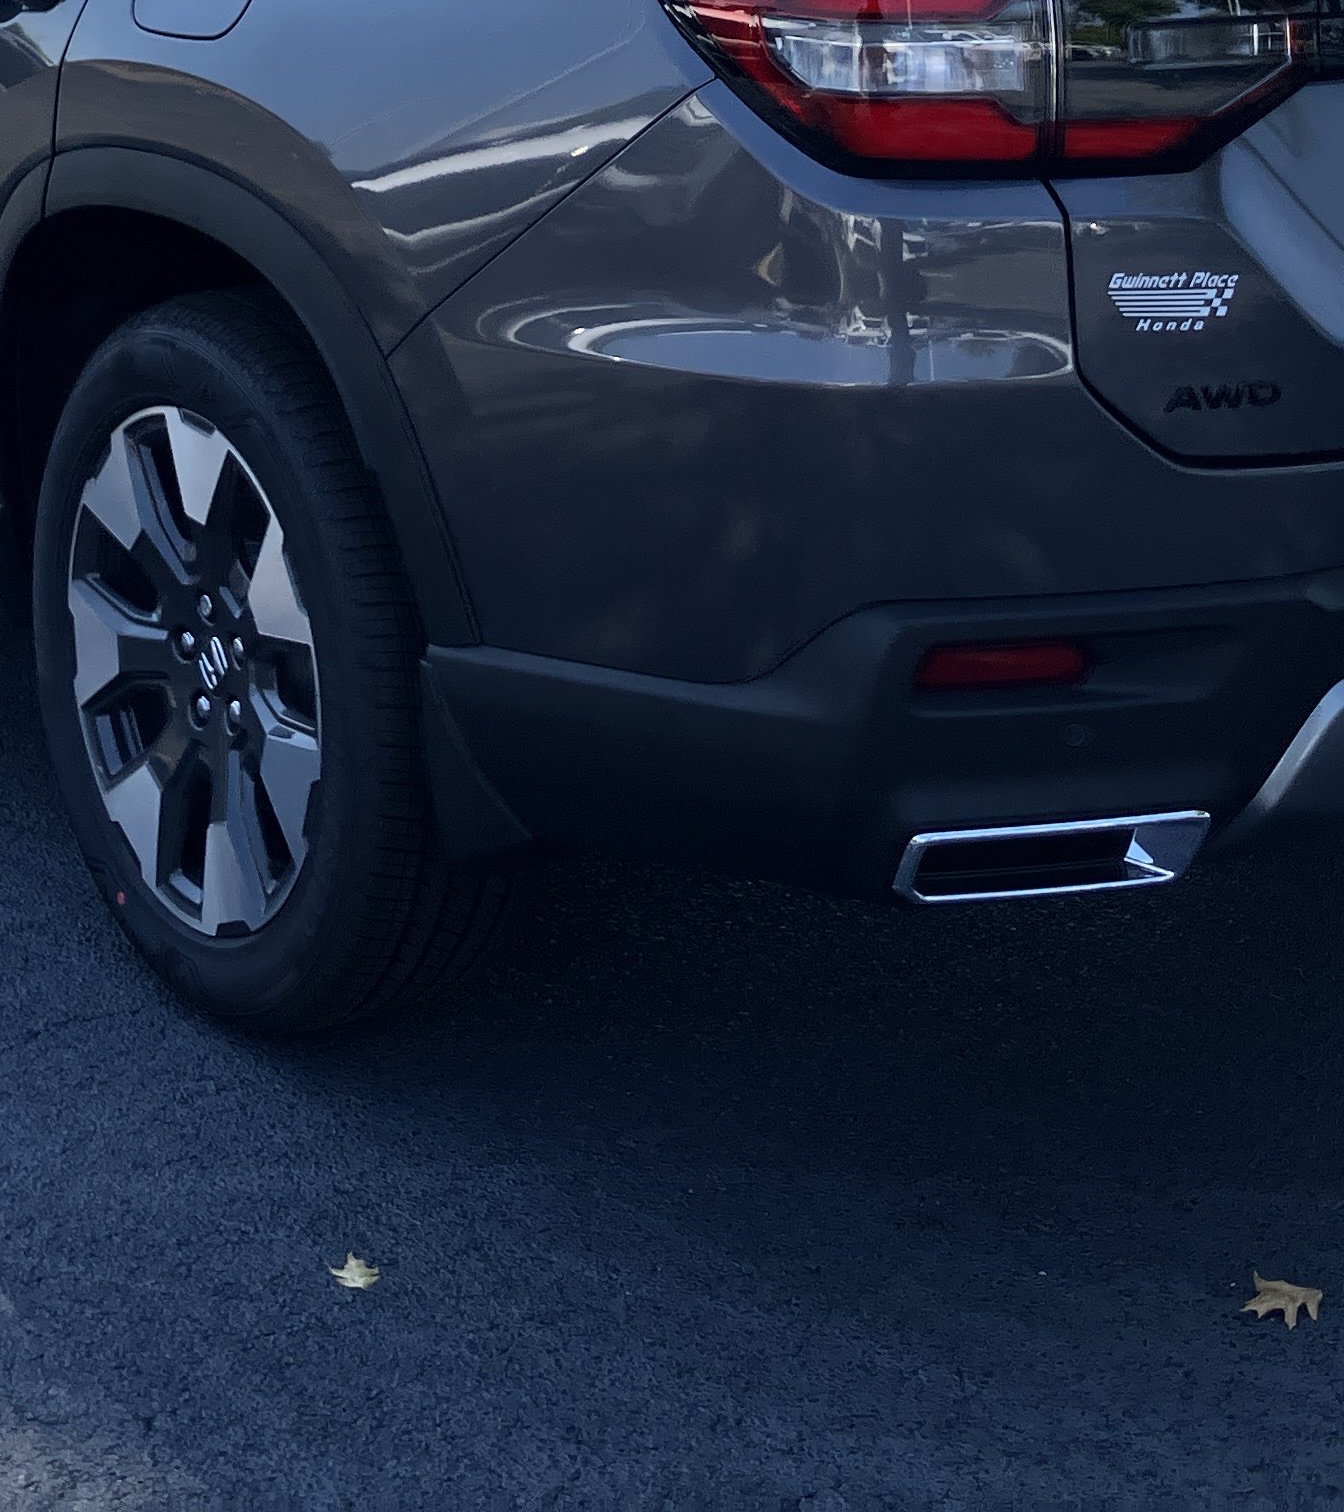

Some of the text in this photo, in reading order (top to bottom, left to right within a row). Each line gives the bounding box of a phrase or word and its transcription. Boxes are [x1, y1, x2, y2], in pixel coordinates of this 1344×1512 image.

[1108, 271, 1239, 289] Gwinnett Place
[1135, 318, 1205, 332] Honda
[1163, 380, 1282, 413] AWD
